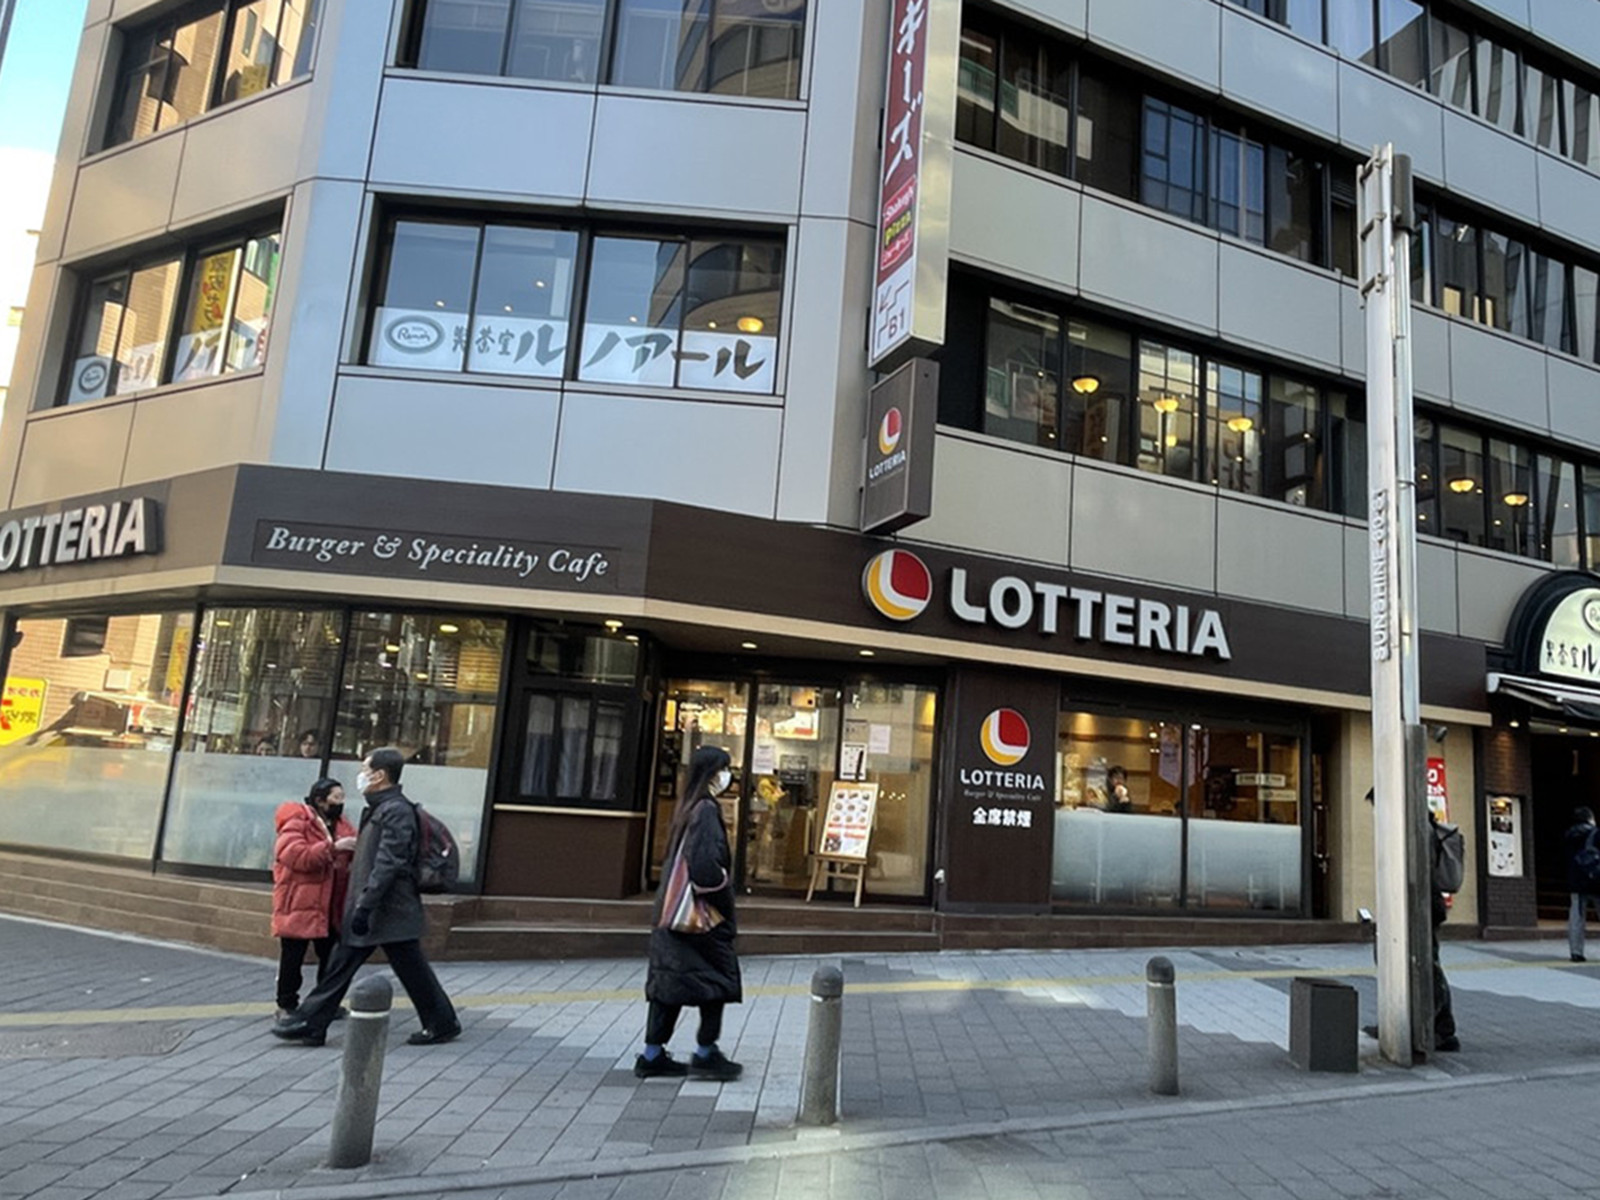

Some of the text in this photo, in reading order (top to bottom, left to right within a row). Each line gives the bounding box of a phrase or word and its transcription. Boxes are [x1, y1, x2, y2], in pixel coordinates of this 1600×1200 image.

[888, 307, 905, 339] B1
[869, 450, 906, 480] LOTTERIA
[0, 497, 147, 571] OTTERIA
[266, 526, 609, 582] Burger & Speciality Cafe
[951, 567, 1231, 660] LOTTERIA
[1546, 640, 1600, 676] 喫茶室ル
[960, 768, 1045, 790] LOTTERIA
